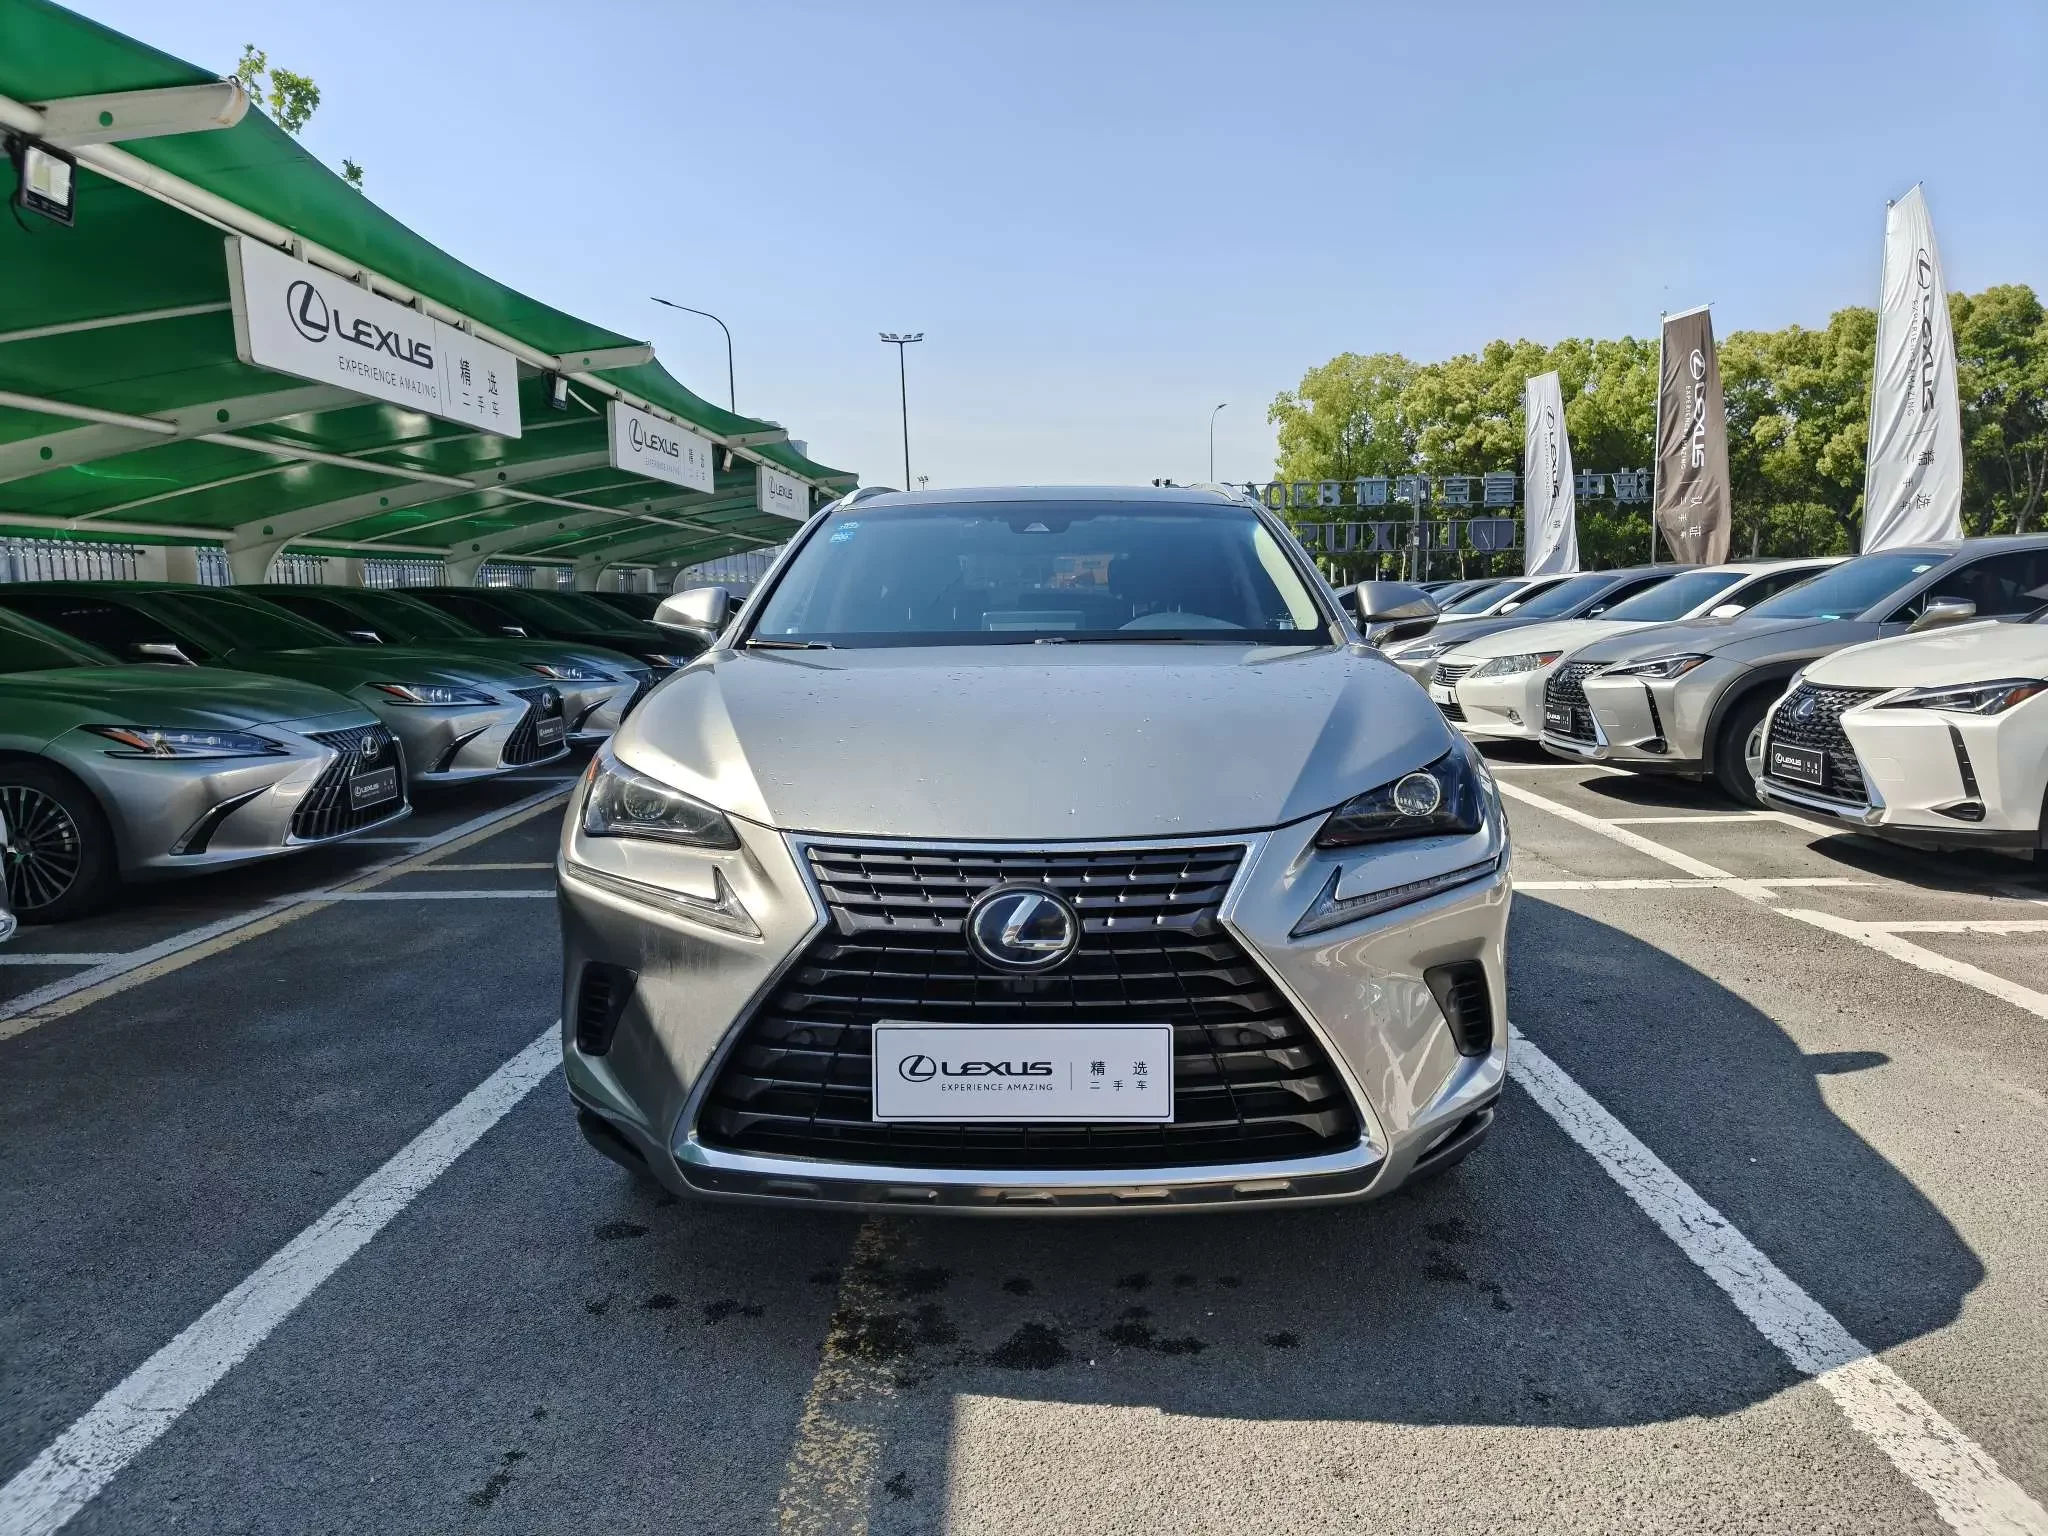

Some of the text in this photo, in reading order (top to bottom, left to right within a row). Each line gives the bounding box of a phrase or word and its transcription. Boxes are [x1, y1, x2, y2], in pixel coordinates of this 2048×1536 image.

[334, 309, 434, 370] LEXUS
[1922, 294, 1934, 413] LEXUS
[339, 356, 436, 399] EXPERIENCE AMAZING
[1691, 381, 1705, 469] LEXUS
[644, 431, 679, 458] LEXUS
[941, 1061, 1053, 1077] LEXUS
[1090, 1060, 1148, 1076] 精选
[941, 1083, 1053, 1091] EXPERIENCE AMAZING
[1090, 1080, 1148, 1091] 二手车
